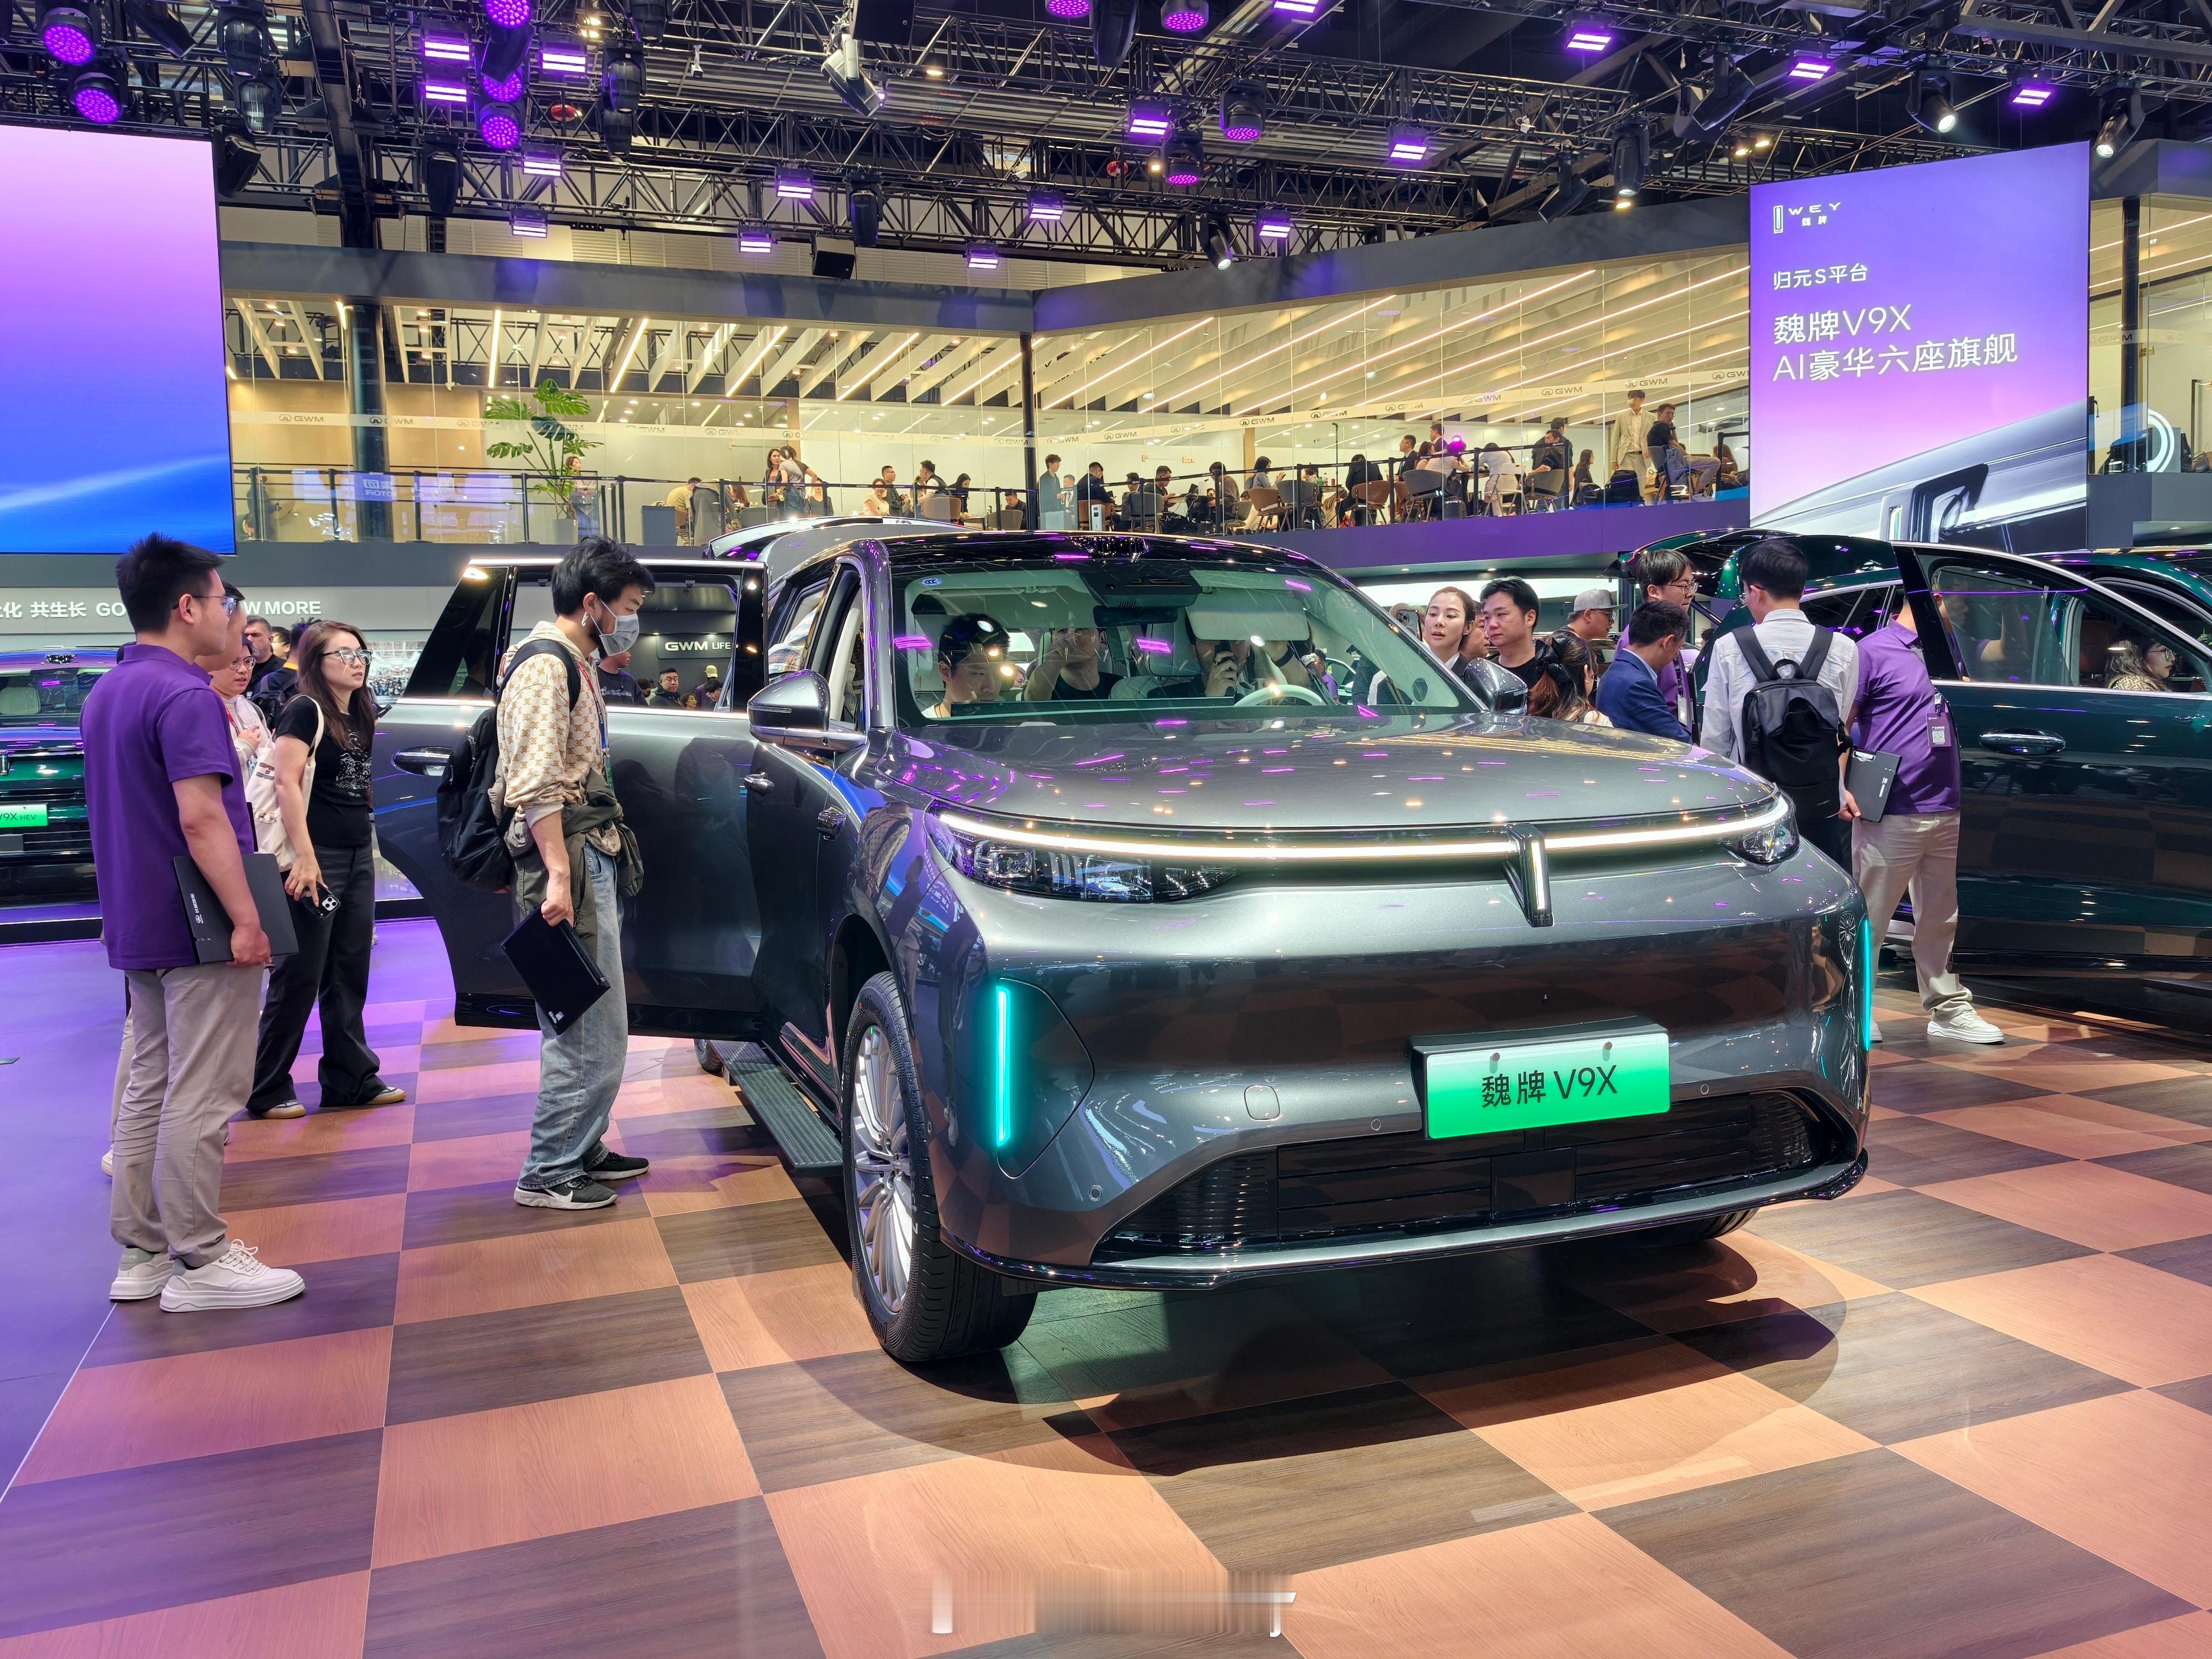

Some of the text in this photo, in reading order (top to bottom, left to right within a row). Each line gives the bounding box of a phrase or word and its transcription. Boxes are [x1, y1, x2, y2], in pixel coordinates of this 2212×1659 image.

[1788, 202, 1841, 215] WEY
[1773, 262, 1868, 290] 归元S平台
[1773, 304, 1912, 345] 魏牌V9X
[1772, 333, 2018, 381] AI豪华六座旗舰
[1727, 370, 1749, 379] GW
[1640, 378, 1668, 387] GWM
[1555, 386, 1582, 395] GWM
[30, 601, 86, 618] 共生长
[265, 601, 321, 615] MORE
[665, 642, 731, 651] GWM LIFE
[1481, 1064, 1618, 1108] 魏牌 V9X
